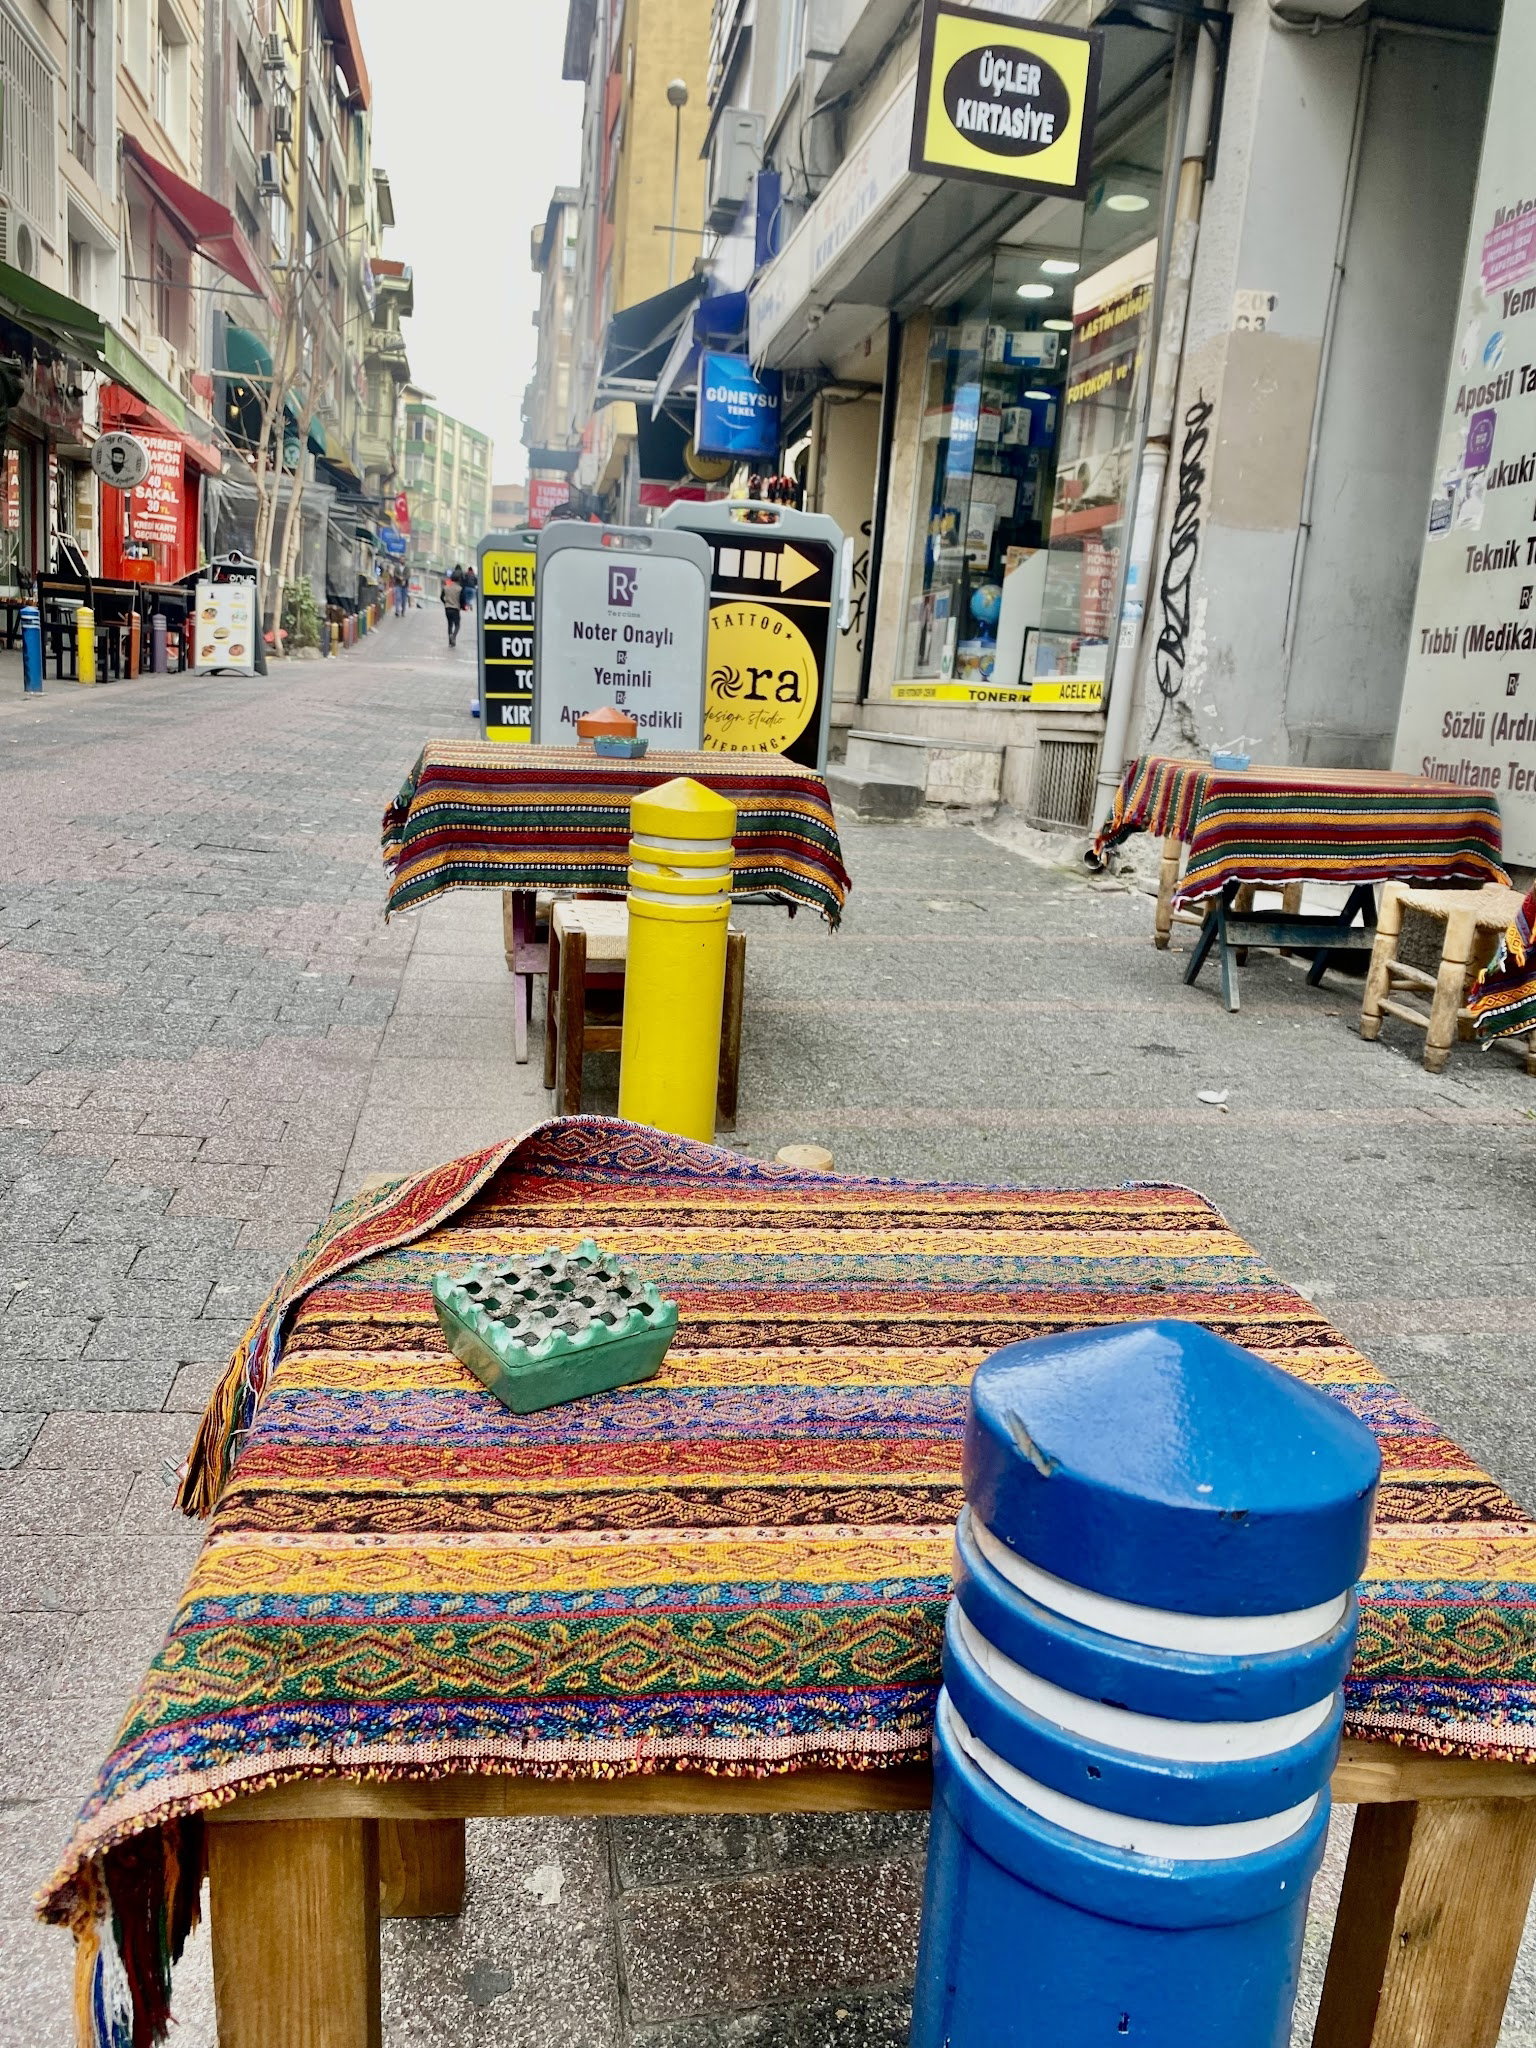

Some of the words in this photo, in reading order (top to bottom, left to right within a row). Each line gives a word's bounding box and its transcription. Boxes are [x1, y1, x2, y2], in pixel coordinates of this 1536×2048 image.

[978, 50, 1042, 97] ÜÇLER
[956, 98, 1055, 144] KIRTASİYE
[705, 386, 778, 409] GÜNEYSU
[1454, 369, 1514, 416] Apostil
[727, 405, 756, 417] TEKEL
[148, 475, 162, 489] 40
[1486, 452, 1536, 491] ukuki
[135, 486, 180, 503] SAKAL
[147, 499, 160, 513] 30
[1465, 539, 1521, 574] Teknik
[492, 561, 529, 591] ÜÇLER
[573, 621, 618, 642] Noter
[623, 624, 674, 648] Onaylı
[711, 613, 783, 635] TATTOO
[1420, 626, 1459, 655] Tıbbi
[594, 667, 652, 688] Yeminli
[1059, 684, 1087, 700] ACELE
[747, 708, 788, 732] studio
[1441, 710, 1486, 739] Sözlü
